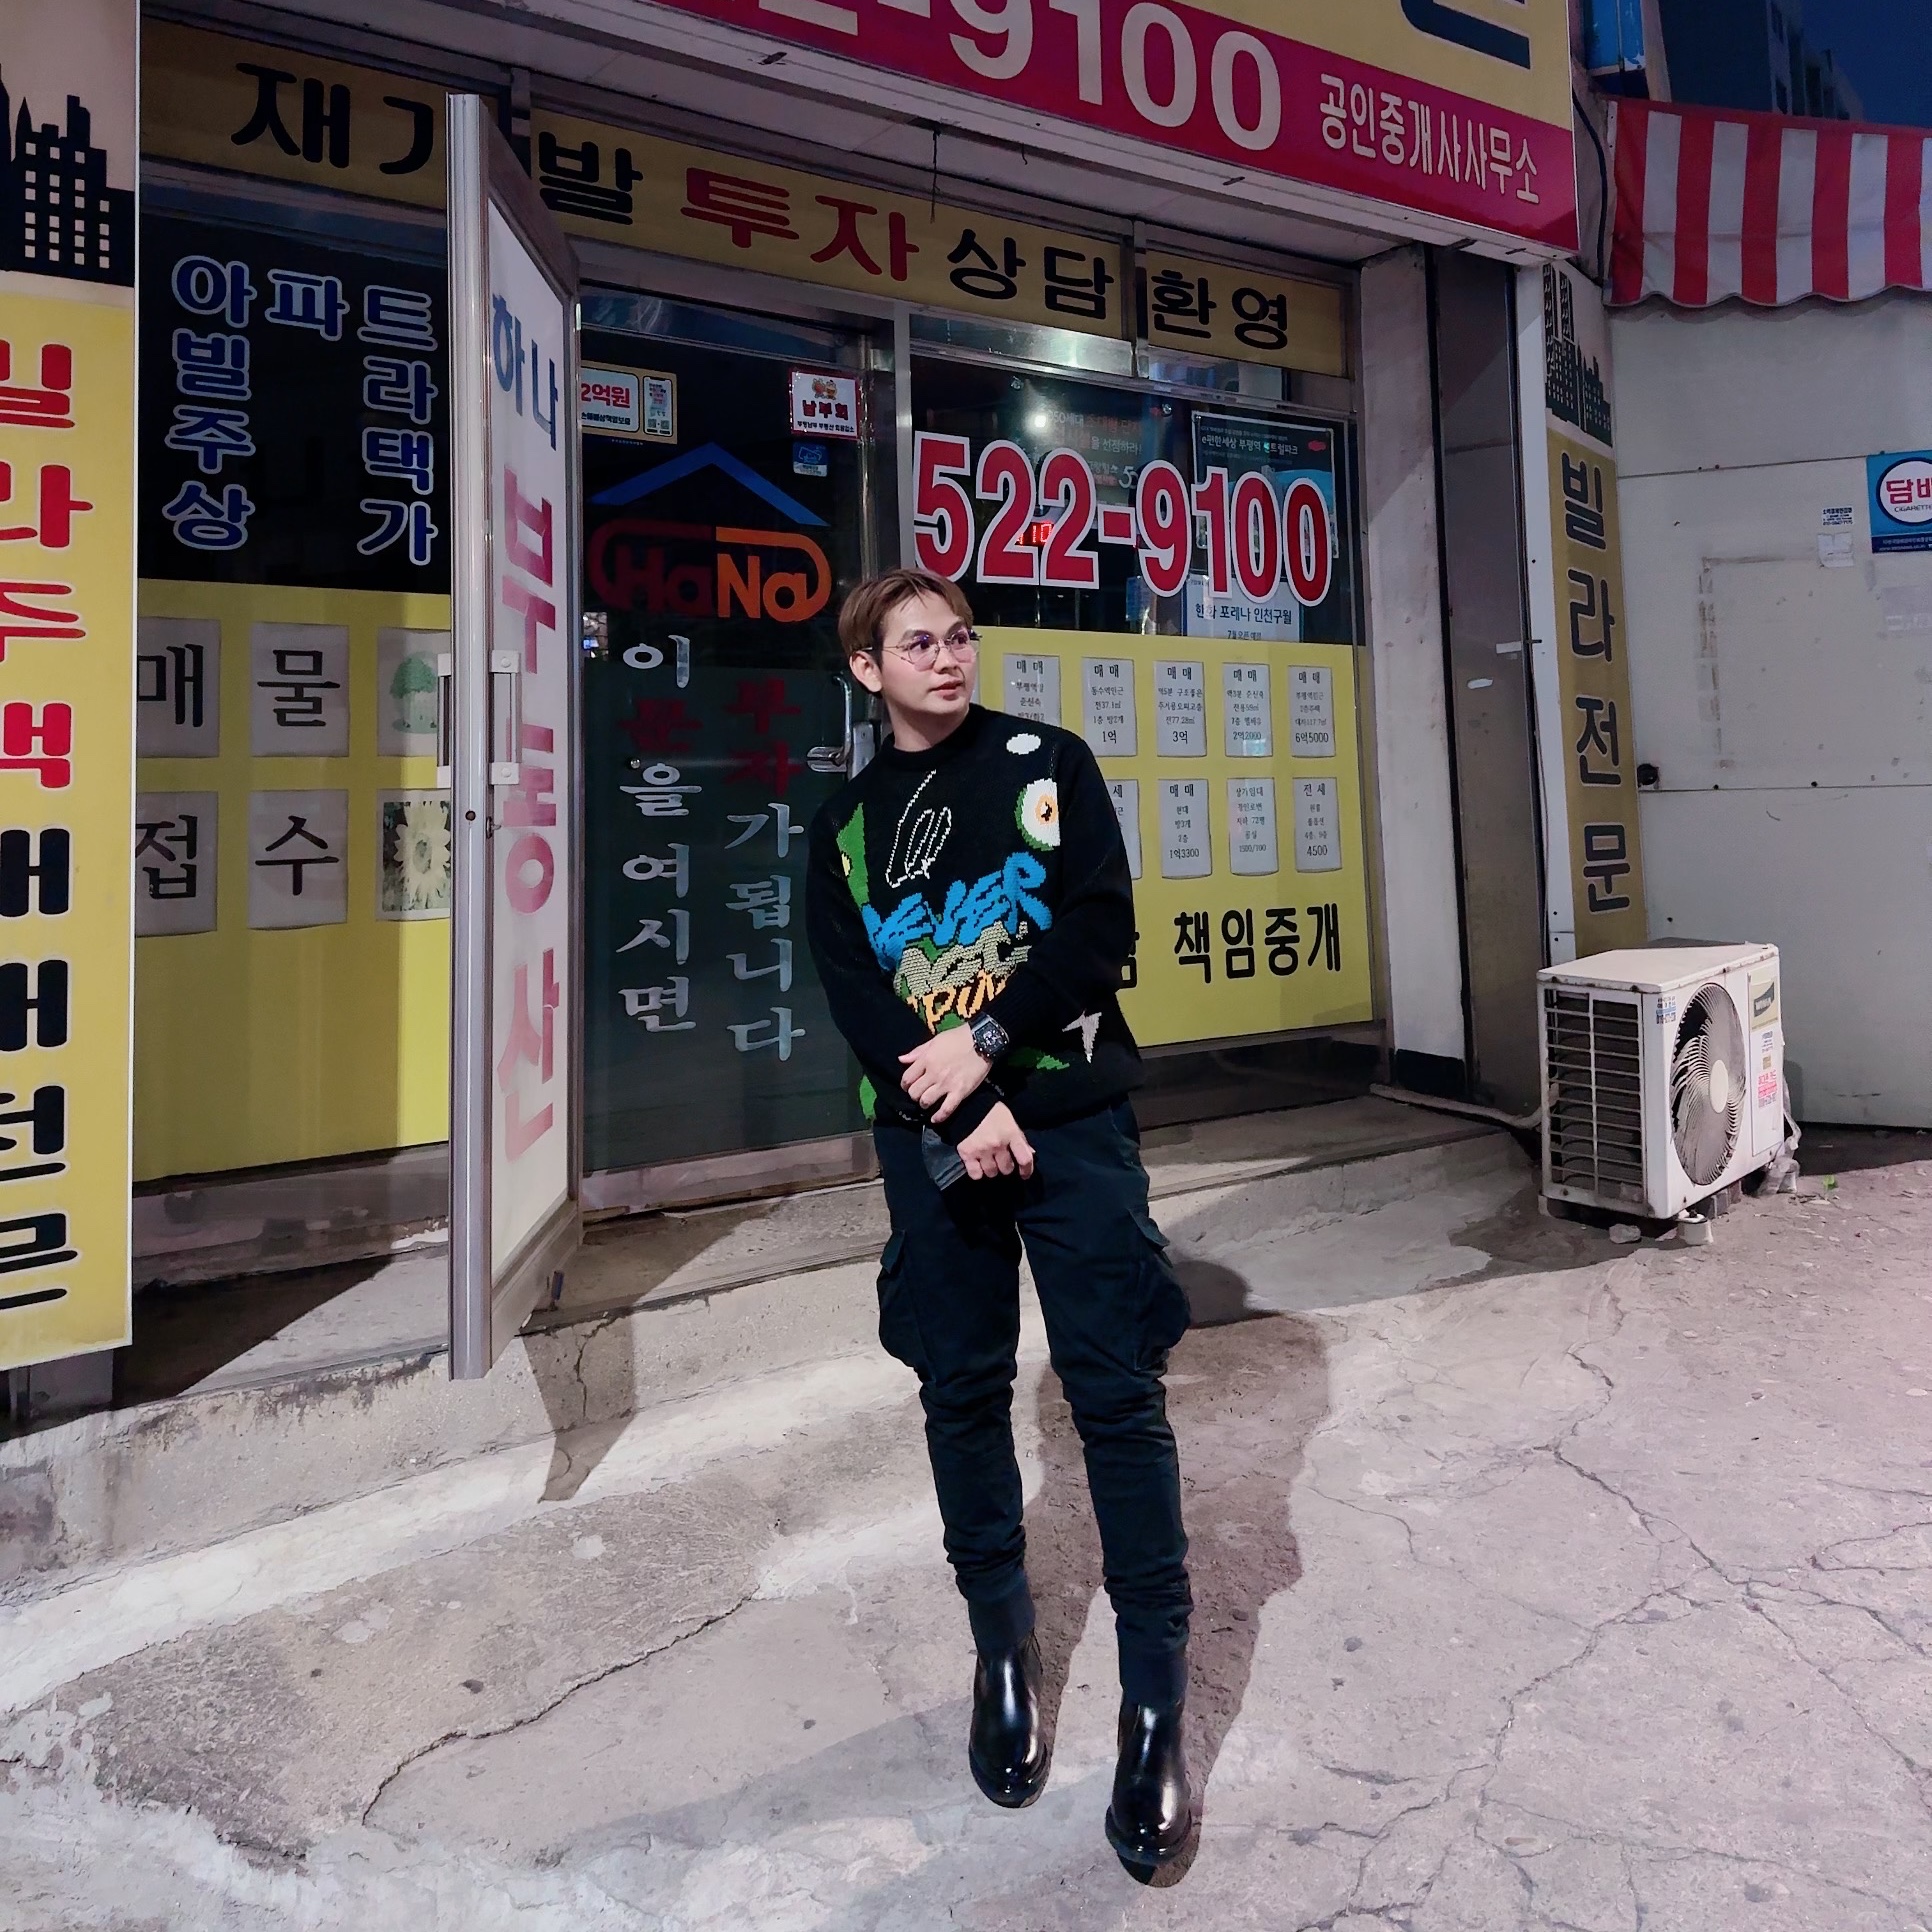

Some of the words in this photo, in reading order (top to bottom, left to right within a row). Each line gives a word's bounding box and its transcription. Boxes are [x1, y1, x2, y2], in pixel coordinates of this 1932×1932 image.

[755, 0, 1281, 151] -9100
[1320, 73, 1540, 204] 공인중개사사무소
[680, 167, 919, 281] 투자
[948, 228, 1114, 320] 상담
[1150, 268, 1288, 350] 환영
[171, 254, 438, 351] 아파트
[492, 293, 559, 451] 하나
[914, 430, 1332, 606] 522-9100
[1219, 605, 1251, 622] 포레나
[1253, 607, 1293, 625] 인천구월
[622, 634, 690, 688] 이
[1016, 660, 1044, 675] 매매
[1094, 664, 1119, 678] 매매
[1167, 666, 1192, 680] 매매
[1233, 668, 1257, 682] 매매
[1298, 671, 1320, 684] 매매
[138, 643, 341, 727] 매물
[1102, 730, 1117, 744] 1억
[1172, 730, 1188, 744] 3억
[1295, 732, 1329, 744] 6억5000
[1169, 783, 1194, 797] 매매
[1303, 783, 1326, 797] 전세
[137, 814, 340, 901] 접수
[1169, 848, 1200, 860] 1억3300
[1306, 845, 1328, 857] 4500
[616, 843, 697, 1032] 여시면
[1173, 902, 1341, 984] 책임중개
[725, 875, 806, 1061] 됩니다
